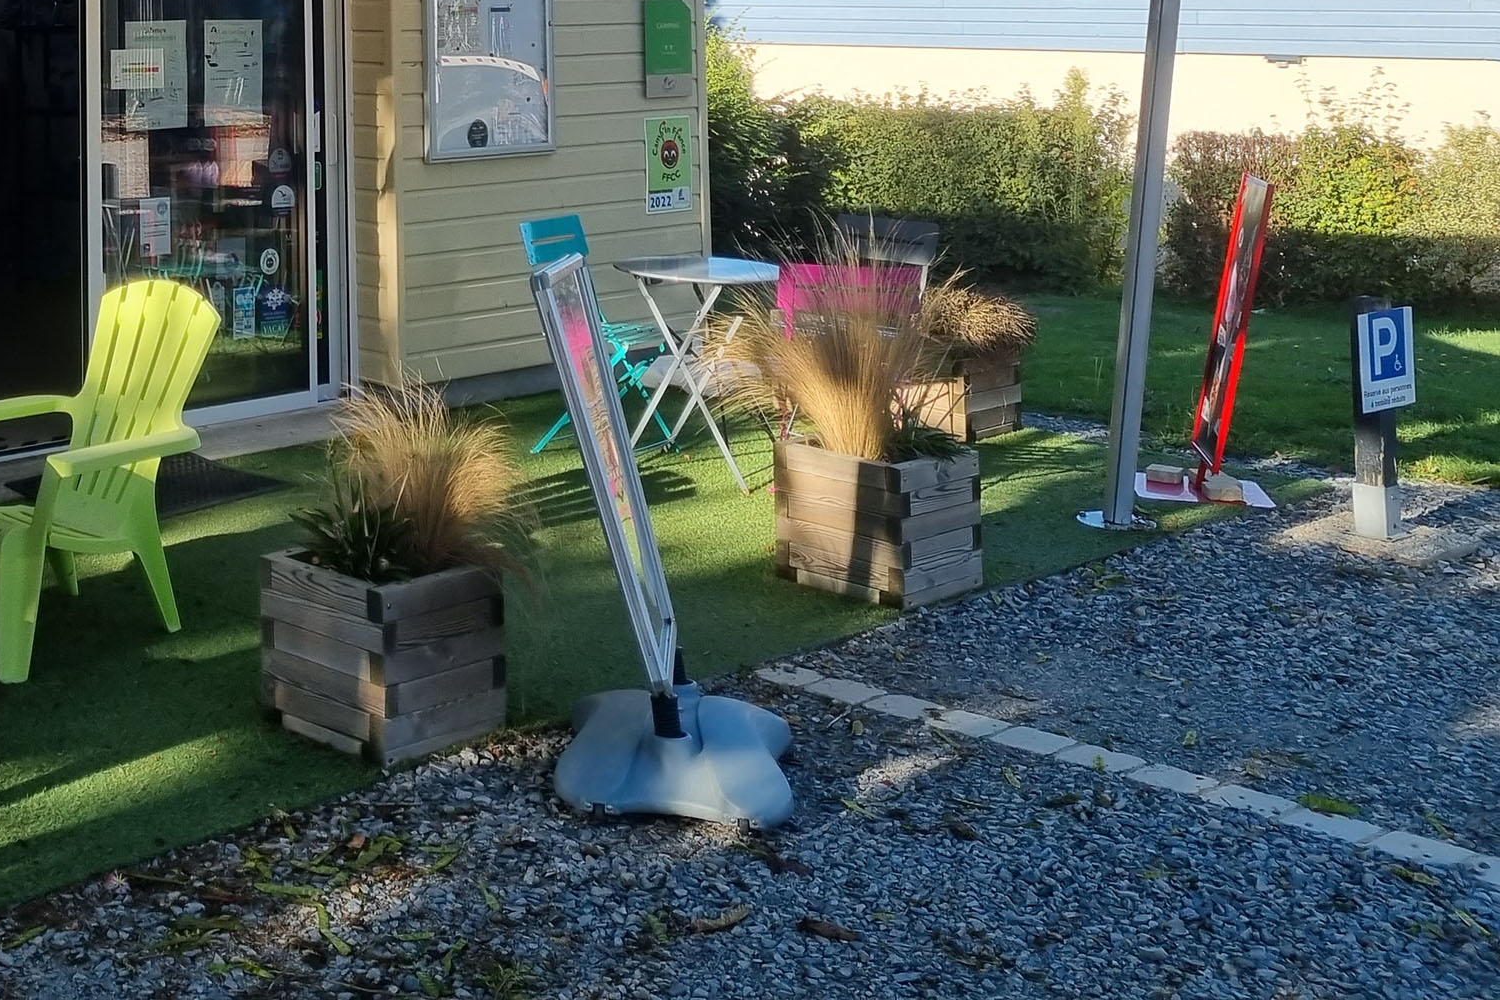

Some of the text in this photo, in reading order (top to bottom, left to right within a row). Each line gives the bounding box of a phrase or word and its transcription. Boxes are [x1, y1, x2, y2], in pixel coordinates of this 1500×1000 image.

[662, 170, 681, 182] FFCC
[650, 195, 672, 208] 2022
[1372, 317, 1397, 376] P
